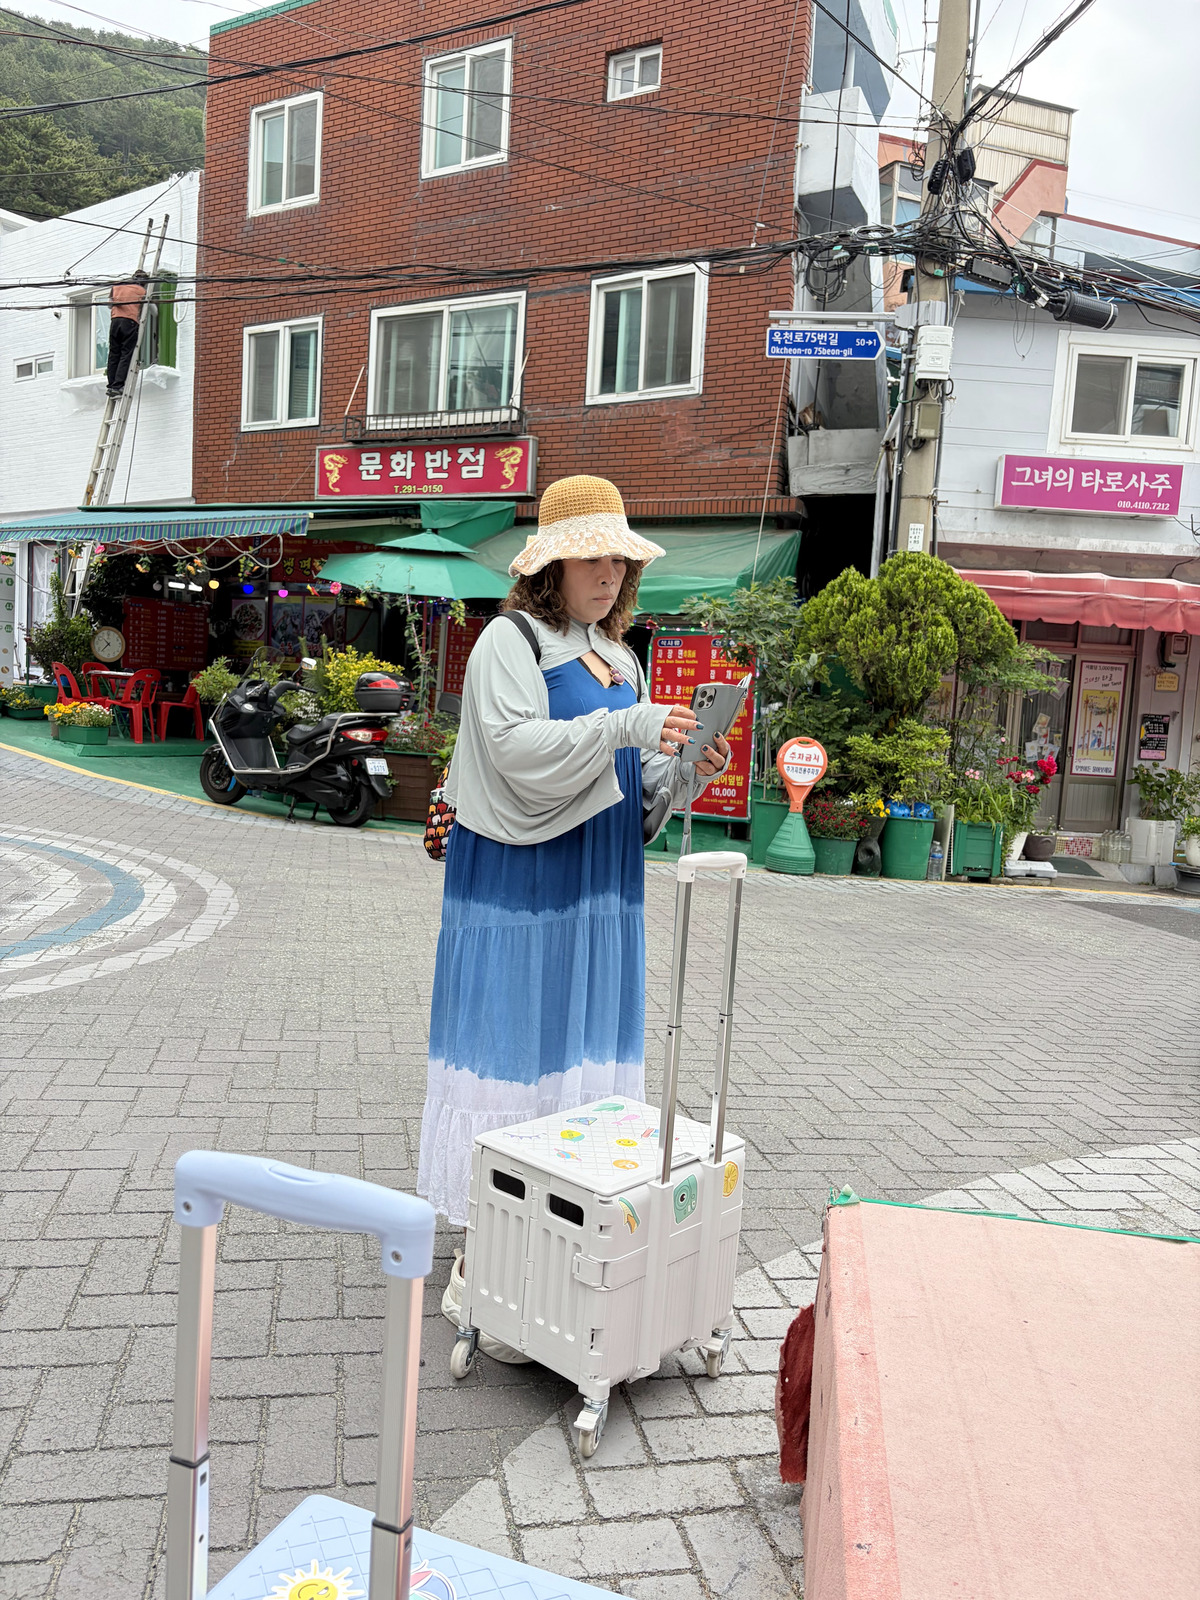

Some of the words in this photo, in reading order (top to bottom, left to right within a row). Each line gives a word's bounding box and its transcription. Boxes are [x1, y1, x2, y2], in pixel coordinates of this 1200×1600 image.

[771, 331, 839, 346] 옥천로75번길
[855, 338, 866, 346] 50
[770, 347, 812, 355] Okcheon-ro
[813, 347, 853, 357] 75beon-gil
[358, 446, 486, 481] 문화반점
[1010, 465, 1075, 493] 그녀의
[1081, 468, 1173, 498] 타로사주
[394, 484, 443, 493] T.291-0150
[1117, 500, 1170, 511] 010.4110.7212
[711, 787, 736, 797] 10,000
